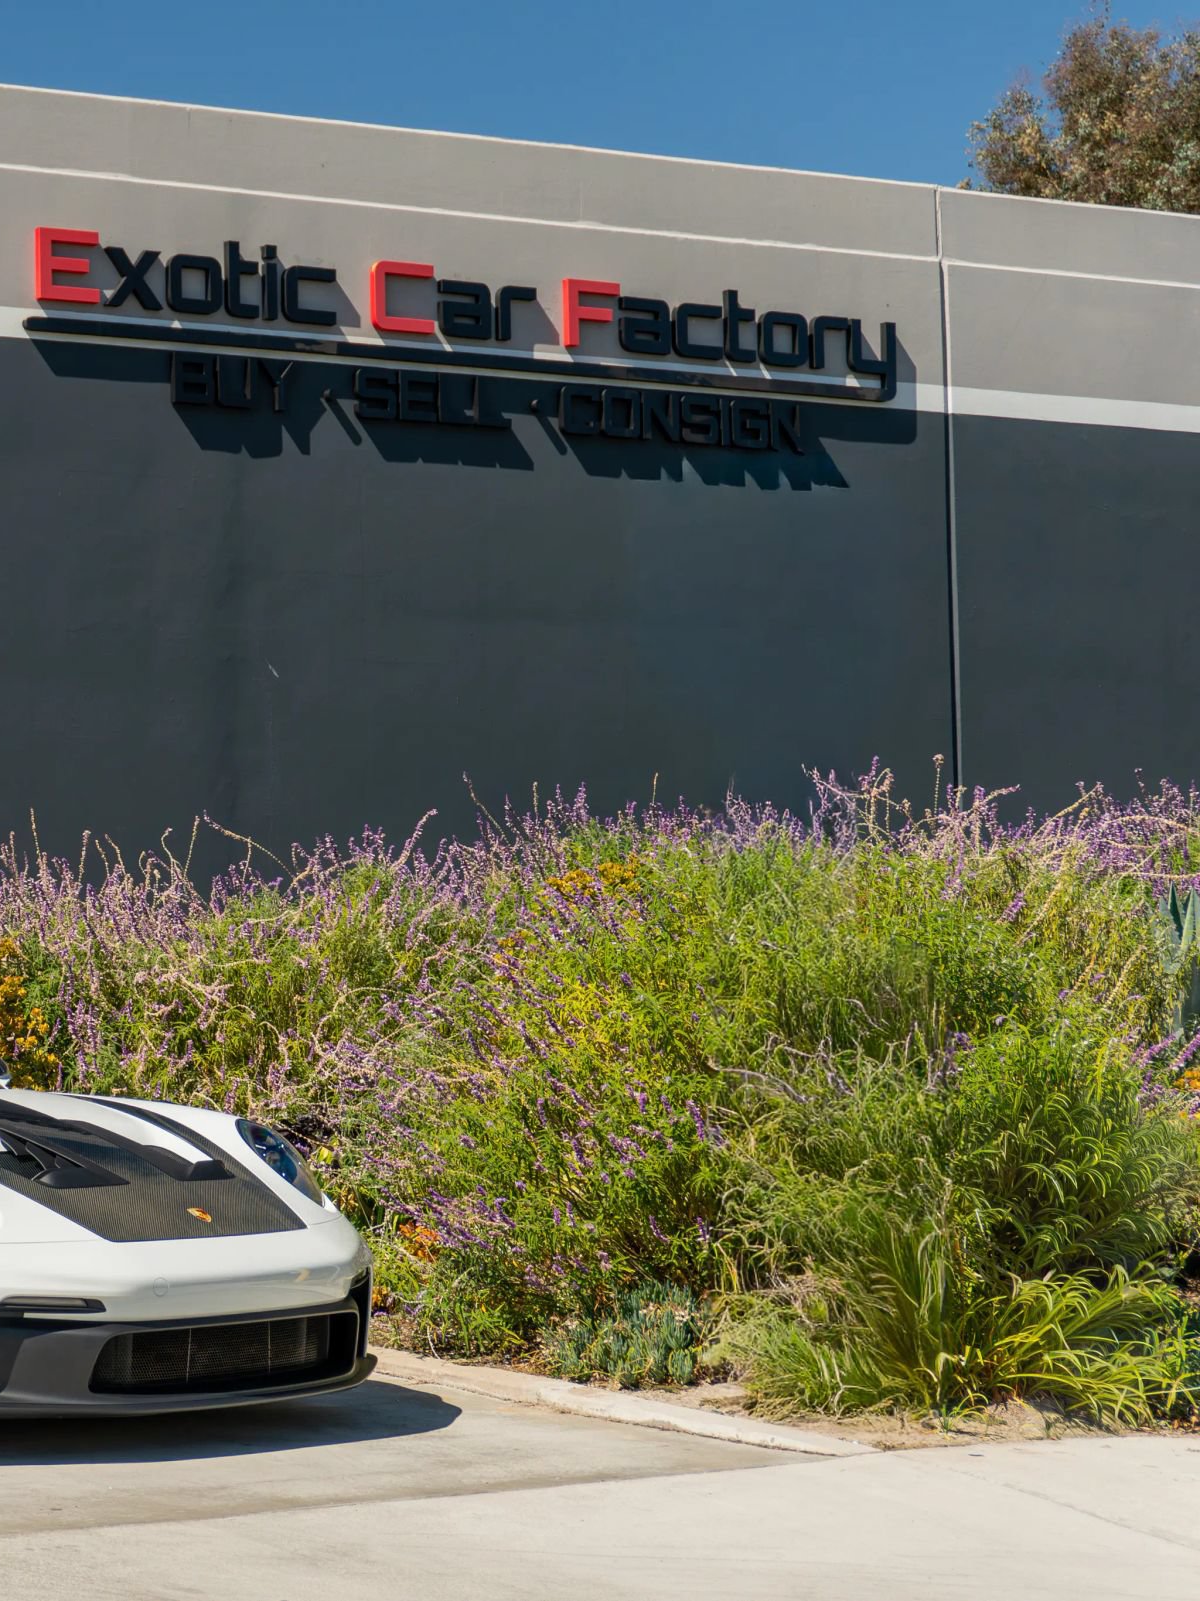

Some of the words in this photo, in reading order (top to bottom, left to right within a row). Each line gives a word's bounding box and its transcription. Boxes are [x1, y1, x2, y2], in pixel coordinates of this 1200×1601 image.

[34, 227, 337, 326] Exotic
[370, 260, 538, 342] Car
[562, 277, 897, 402] Factory
[170, 350, 294, 412] BUY
[353, 366, 512, 428] SELL
[558, 384, 805, 456] CONSIGN
